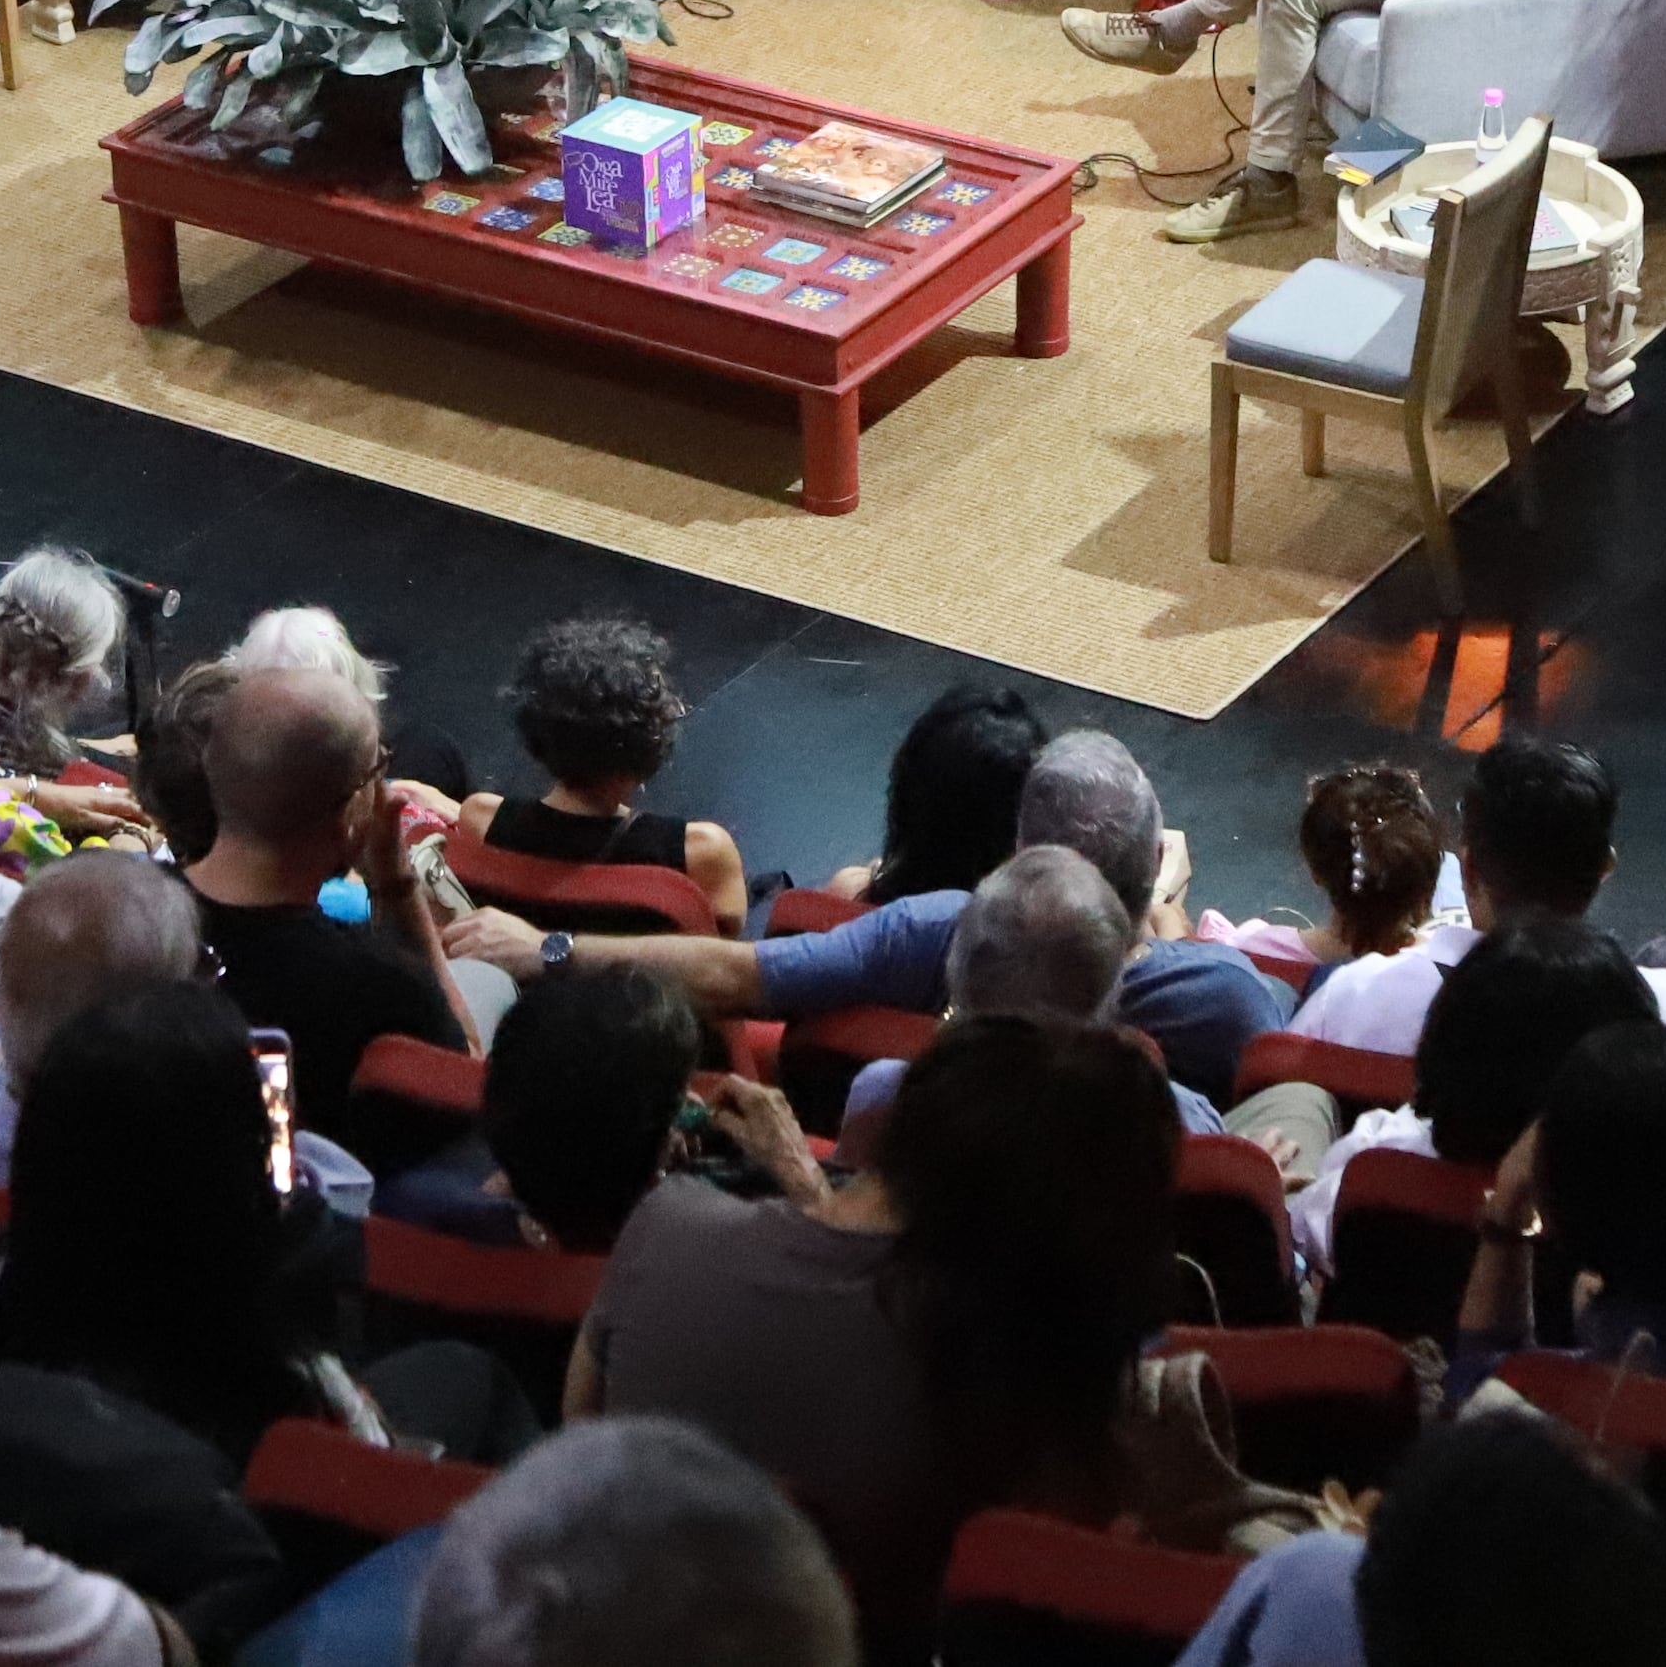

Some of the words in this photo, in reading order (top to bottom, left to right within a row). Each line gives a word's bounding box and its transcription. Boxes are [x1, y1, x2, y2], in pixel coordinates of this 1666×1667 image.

[579, 167, 618, 194] Mire
[582, 152, 624, 181] Oiga
[585, 185, 616, 213] Lea
